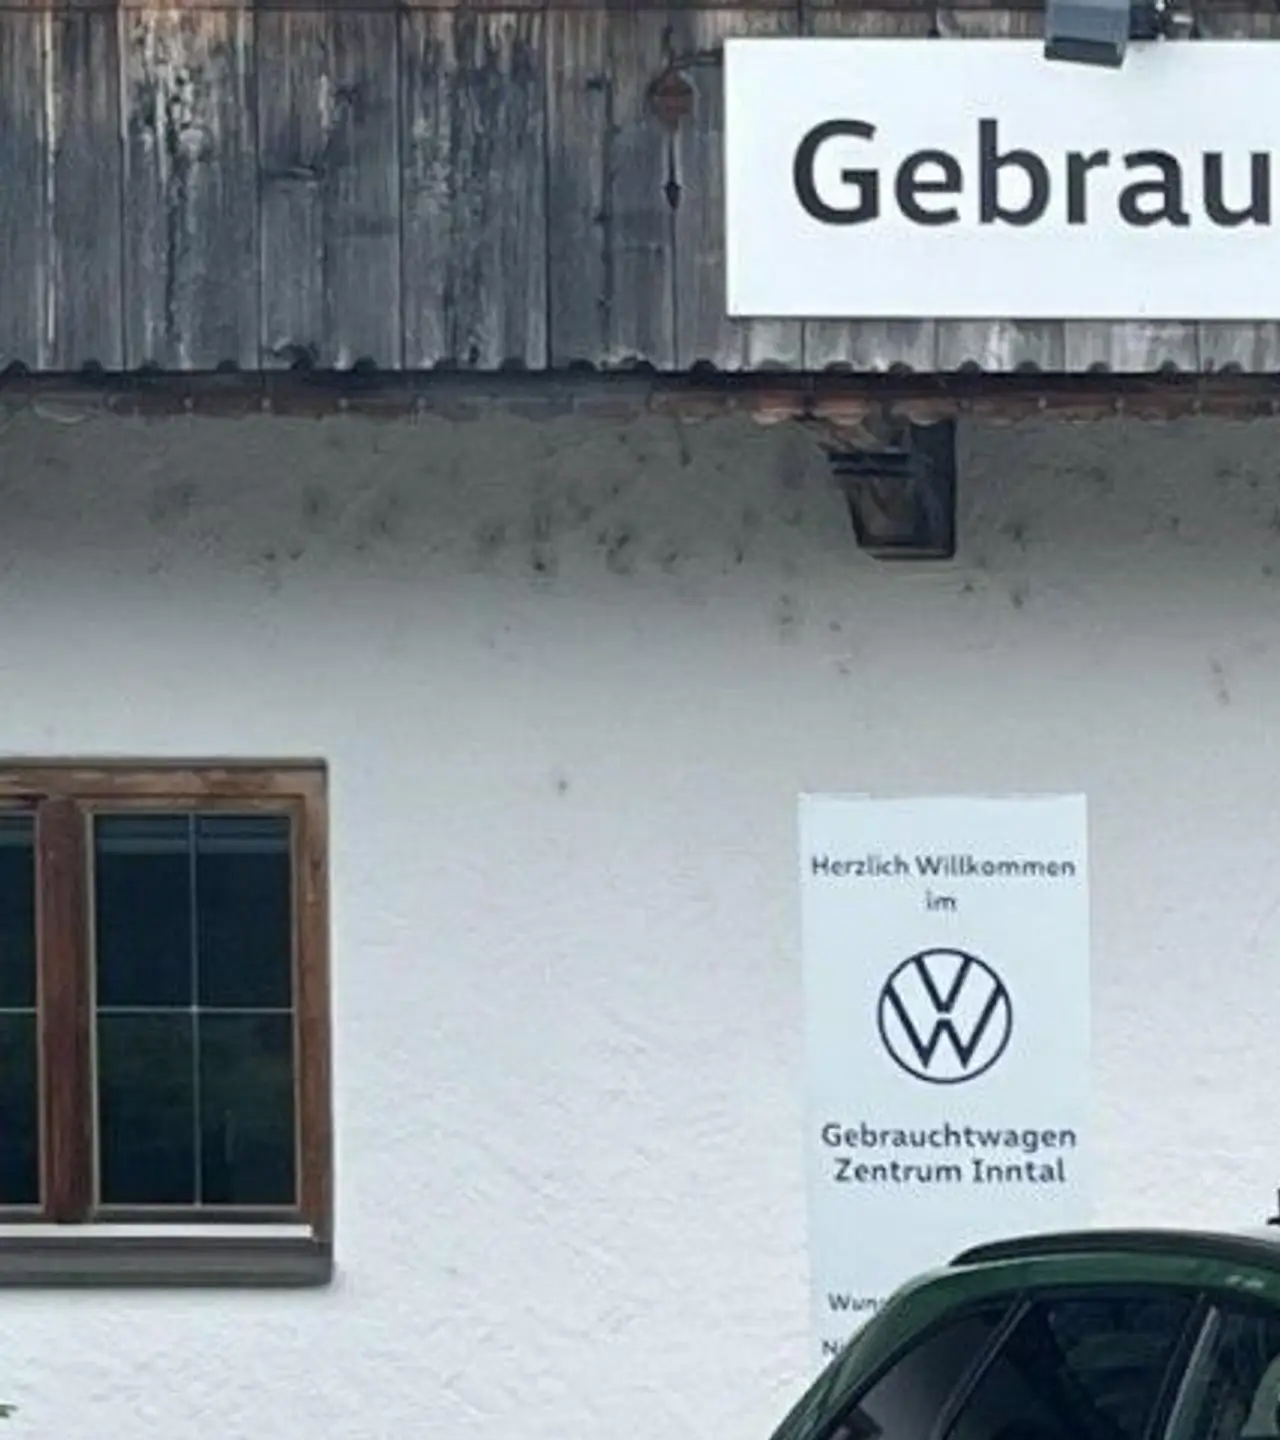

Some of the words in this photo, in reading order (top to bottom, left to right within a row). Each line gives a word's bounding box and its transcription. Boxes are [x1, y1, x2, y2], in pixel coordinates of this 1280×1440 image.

[811, 854, 910, 877] Herzlich
[914, 854, 1076, 878] Willkommen
[925, 890, 958, 912] im
[820, 1121, 1077, 1154] Gebrauchtwagen
[834, 1157, 963, 1184] Zentrum
[971, 1156, 1066, 1184] Inntal
